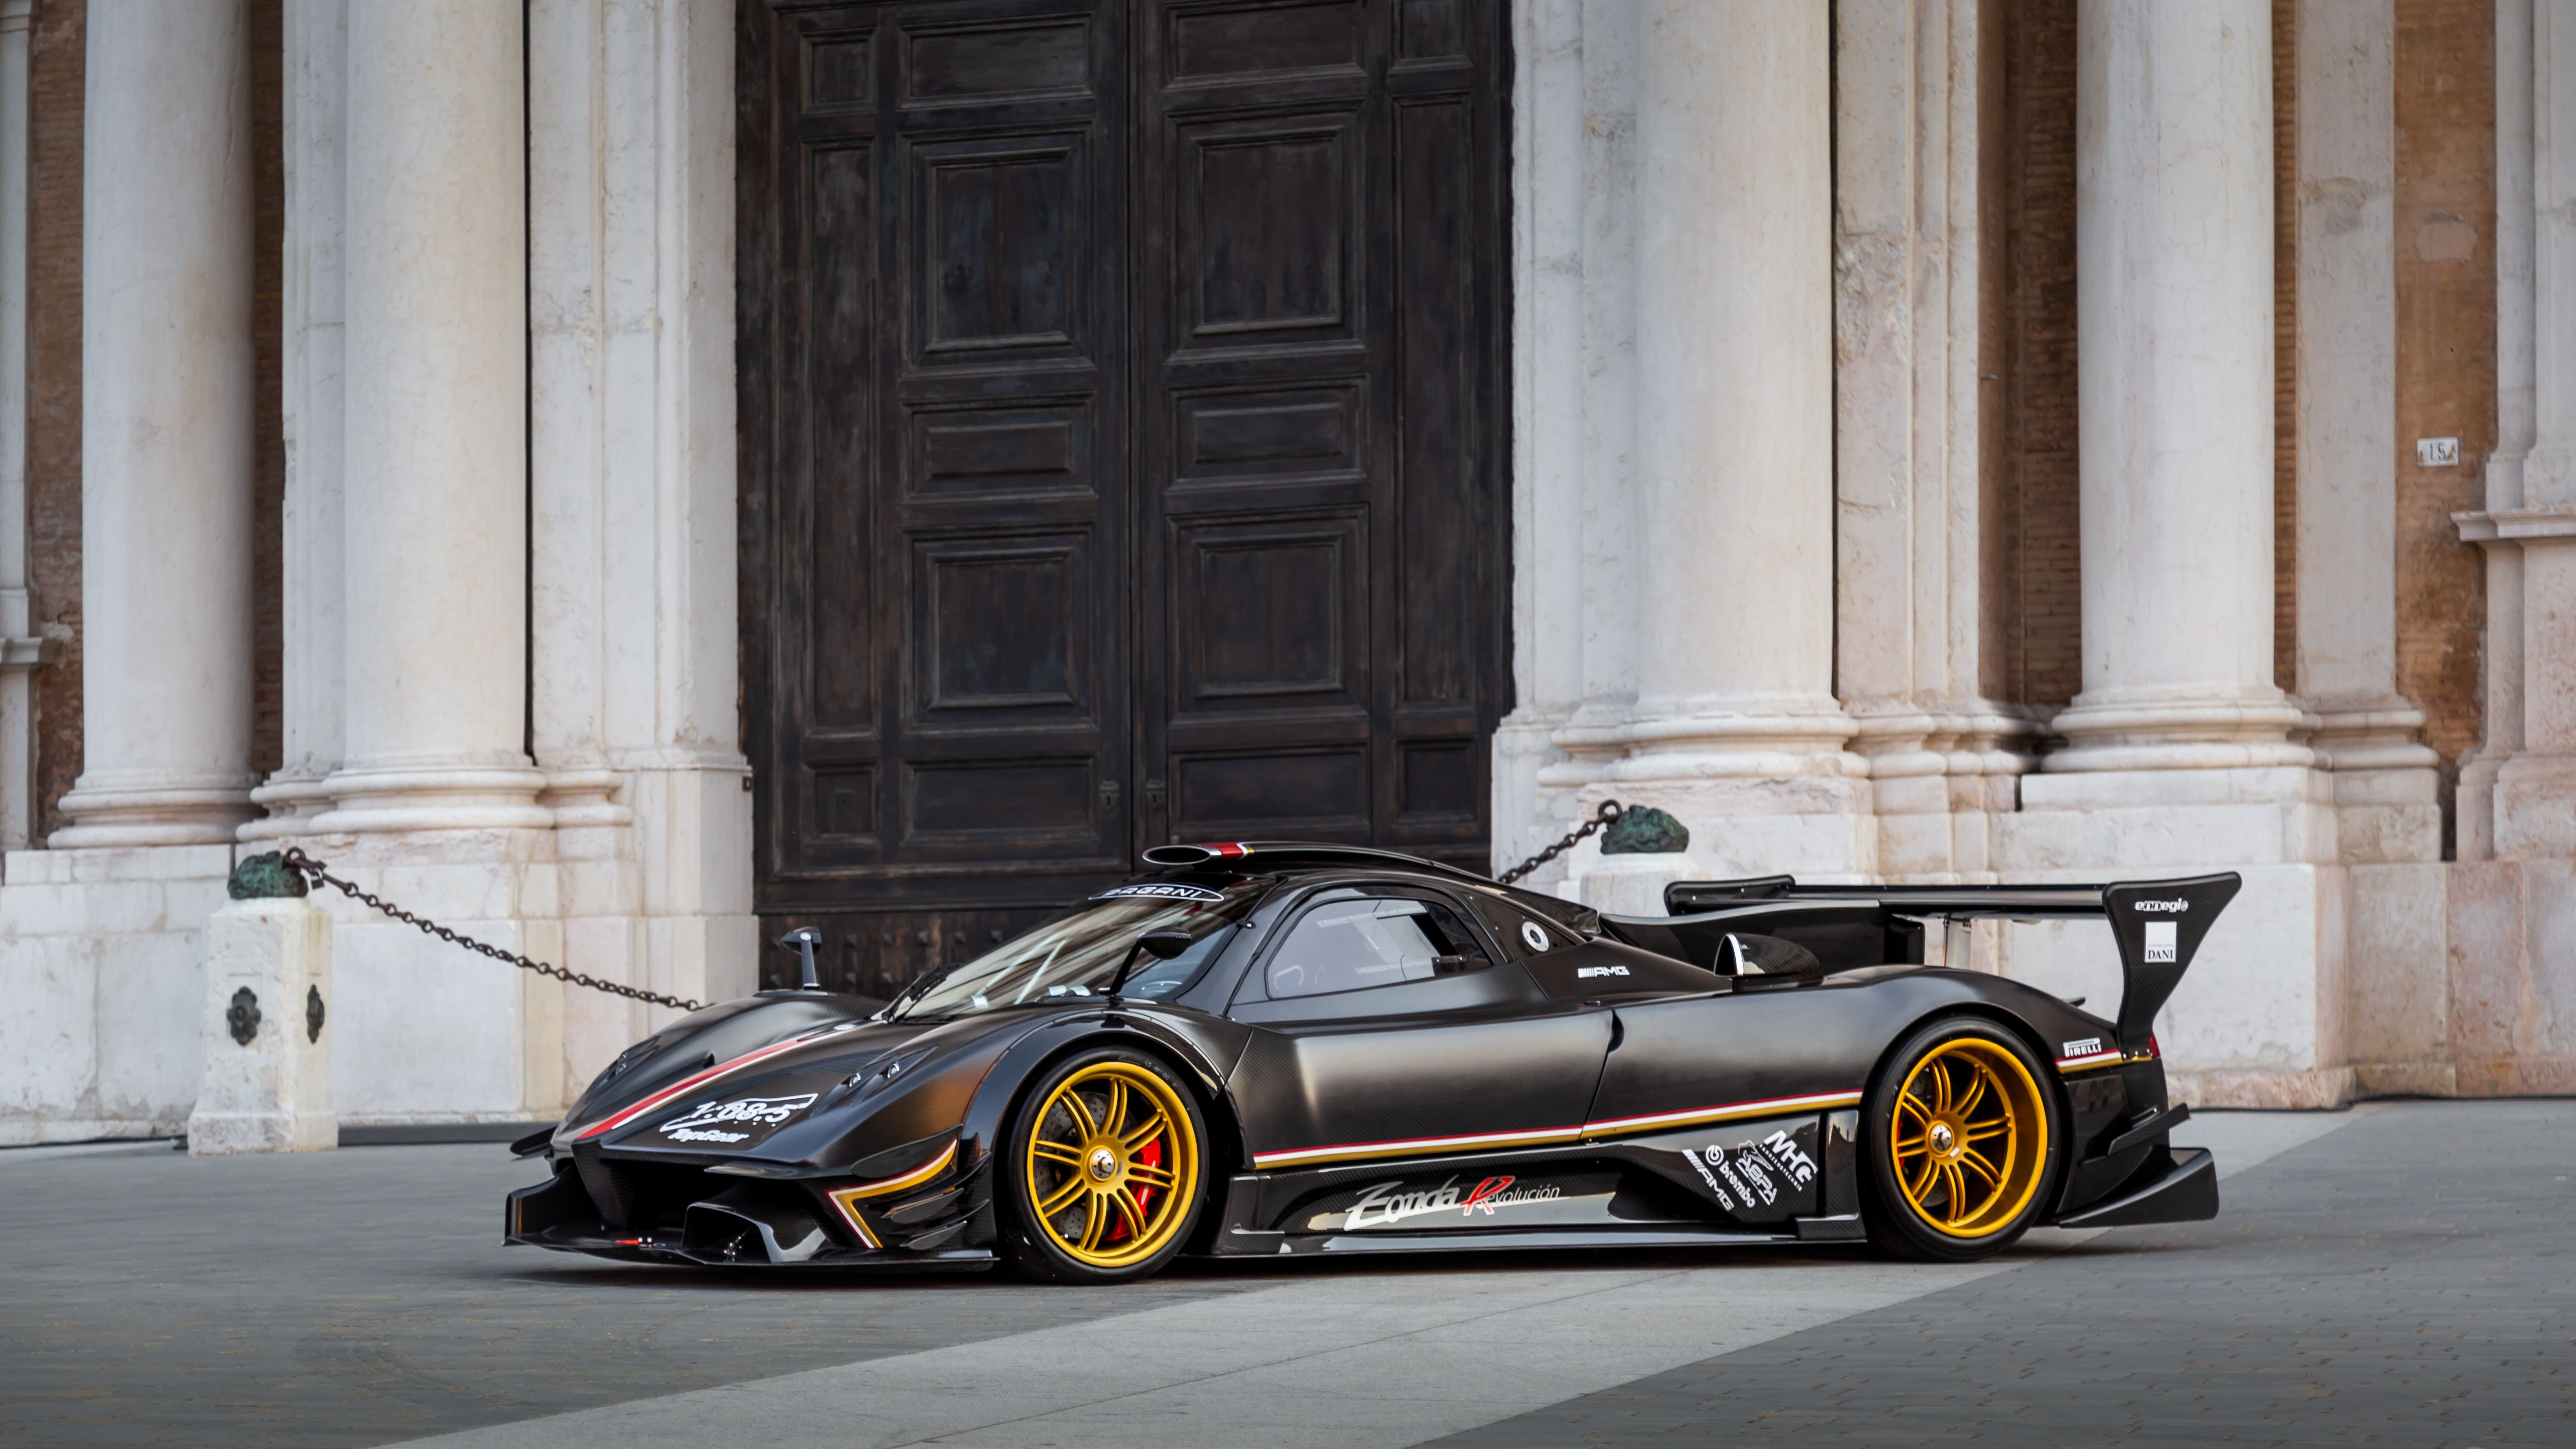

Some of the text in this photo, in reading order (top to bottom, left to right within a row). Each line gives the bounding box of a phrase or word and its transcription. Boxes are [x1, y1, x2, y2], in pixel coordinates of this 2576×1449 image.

[1103, 886, 1202, 898] PAGANI
[2148, 950, 2173, 959] DANI
[2063, 1037, 2101, 1057] PIRELLI
[1719, 1160, 1755, 1208] brembo
[1344, 1175, 1460, 1231] Zonda
